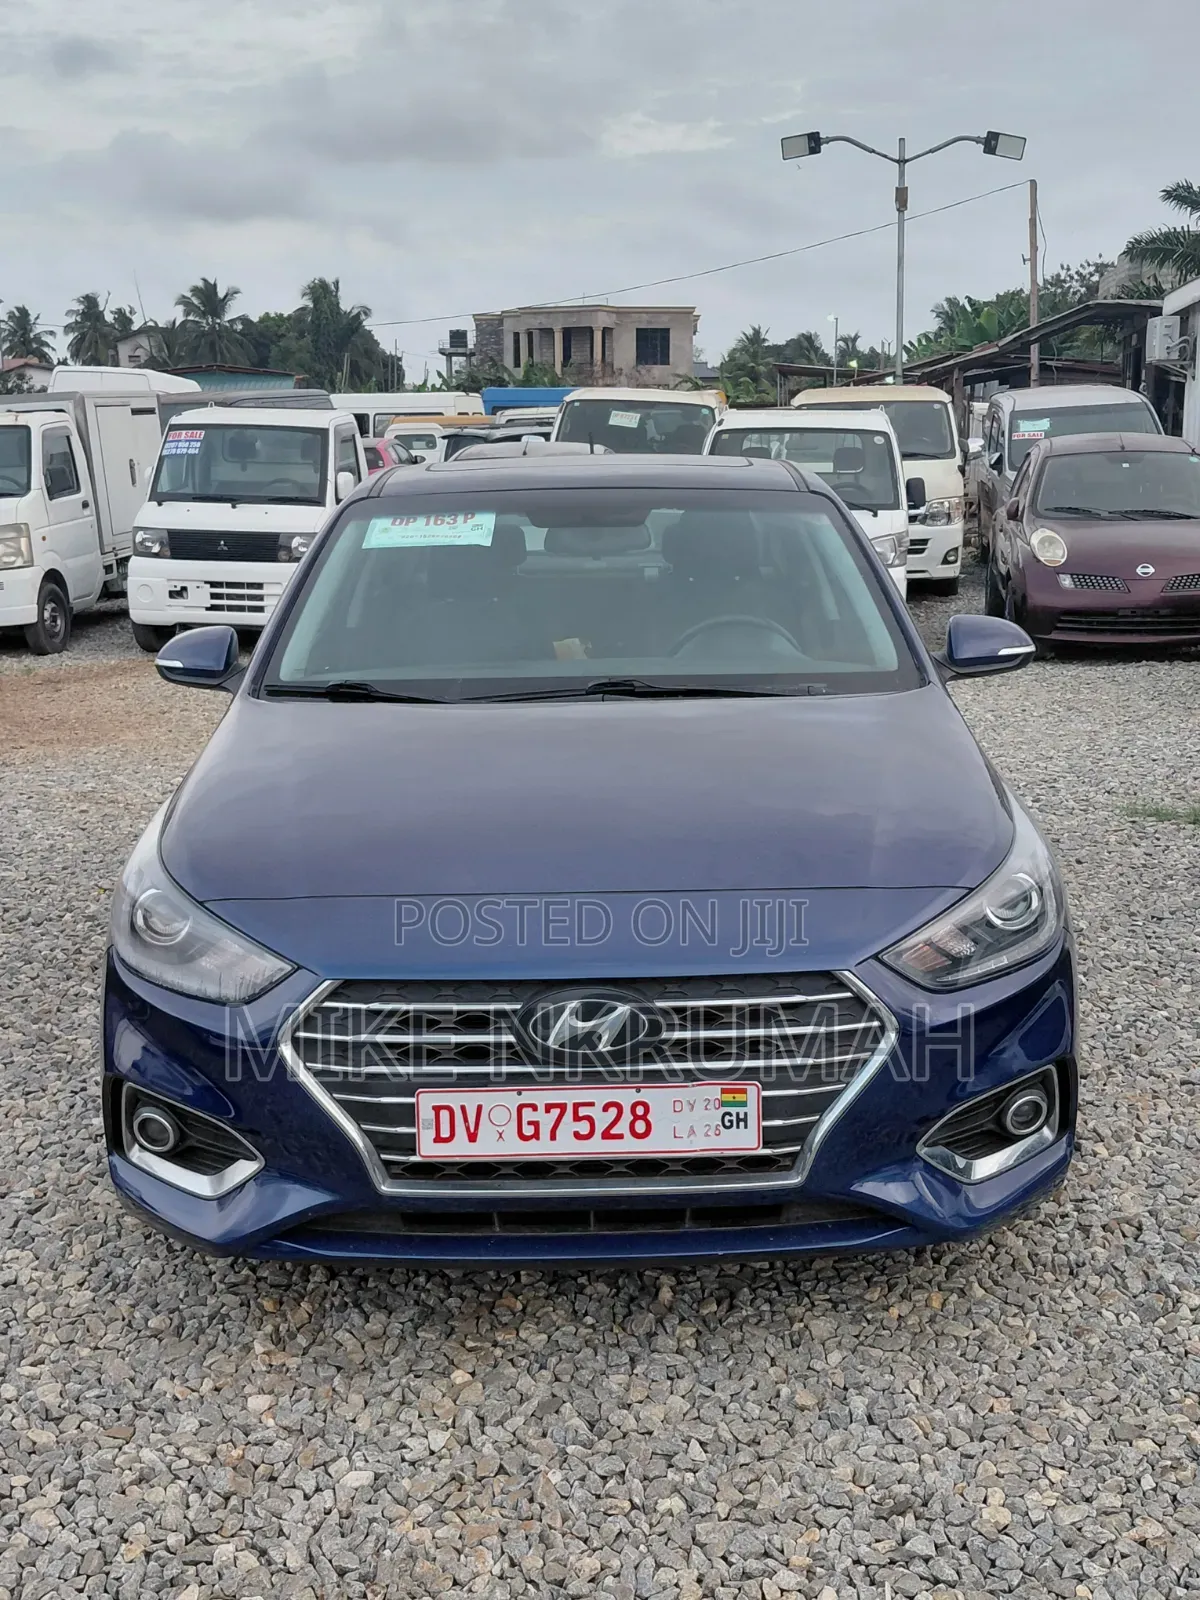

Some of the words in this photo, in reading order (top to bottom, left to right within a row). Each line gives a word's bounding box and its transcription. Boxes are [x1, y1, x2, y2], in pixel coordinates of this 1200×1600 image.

[168, 432, 183, 440] FOR
[184, 431, 204, 439] SALE
[424, 512, 459, 527] 163
[462, 511, 476, 525] P
[672, 1098, 697, 1113] DV
[703, 1097, 721, 1111] 20
[431, 1103, 484, 1144] DV
[516, 1100, 653, 1142] G7528
[720, 1111, 749, 1130] GH
[673, 1125, 697, 1139] LA
